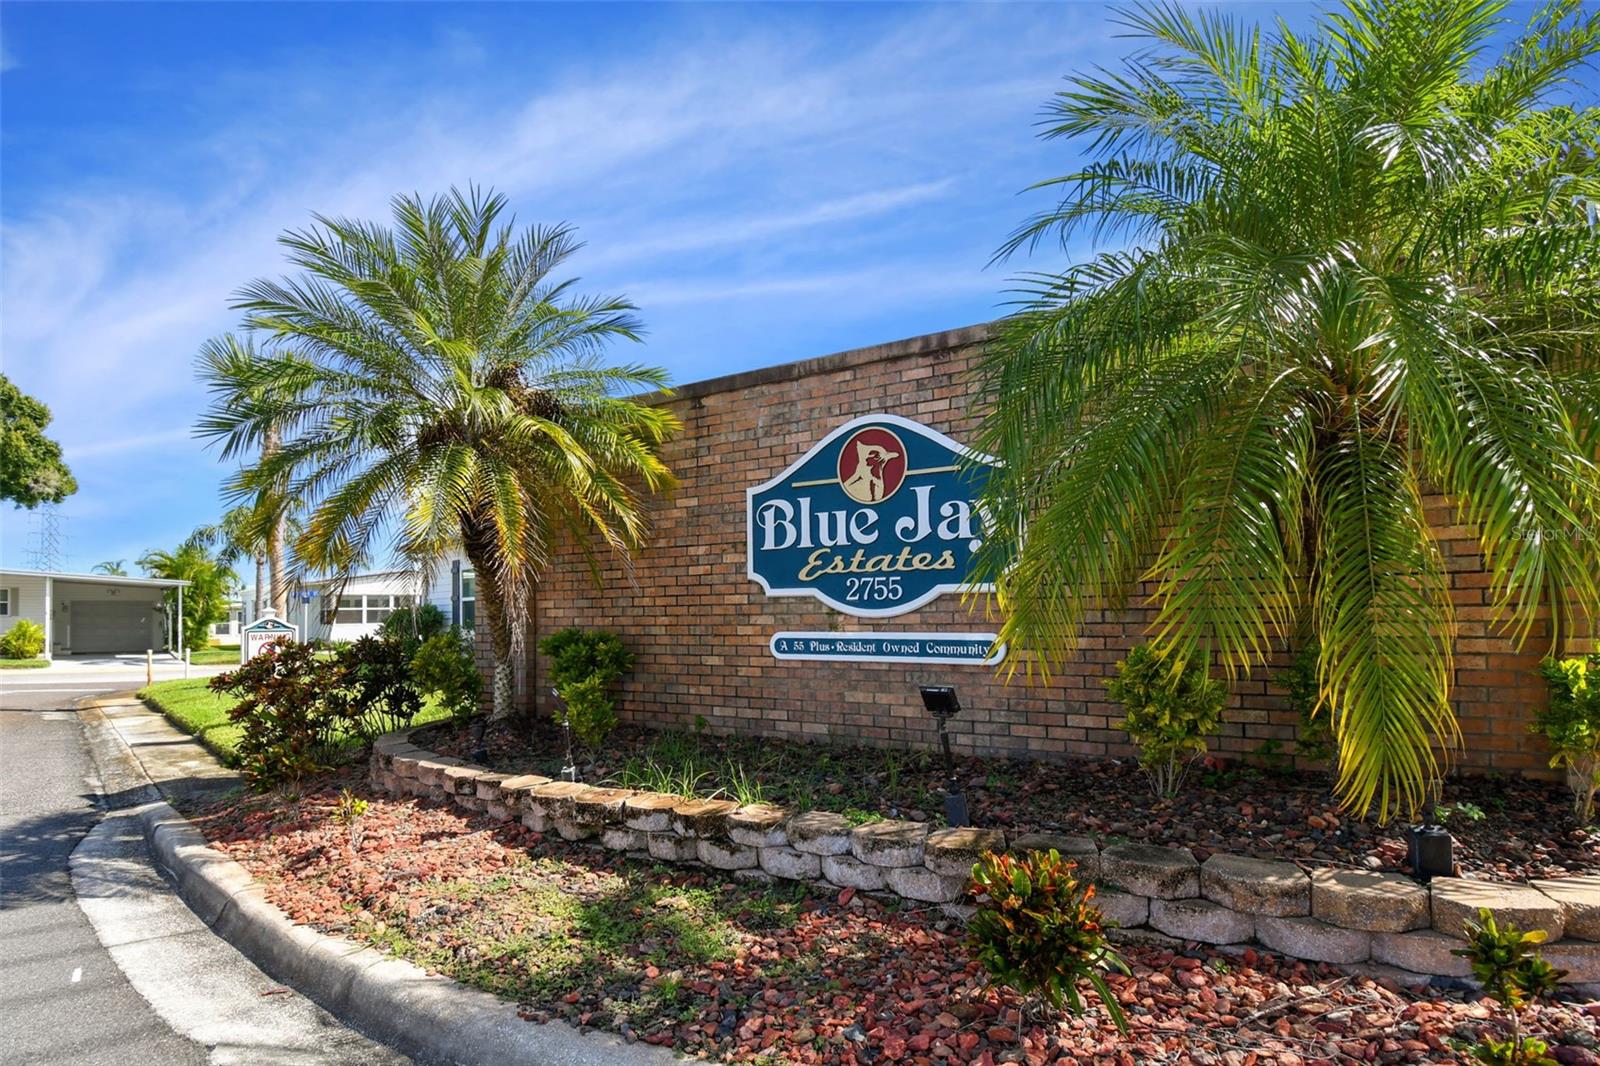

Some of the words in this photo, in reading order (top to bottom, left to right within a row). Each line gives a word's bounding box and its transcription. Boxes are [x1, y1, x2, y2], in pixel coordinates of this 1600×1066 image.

[756, 497, 879, 551] Blue
[798, 546, 956, 581] Estates
[846, 576, 903, 601] 2755
[780, 640, 788, 651] A
[793, 641, 805, 651] 55
[810, 640, 830, 652] Plus
[836, 641, 876, 653] Resident
[883, 641, 919, 654] Owned
[926, 642, 990, 657] Community
